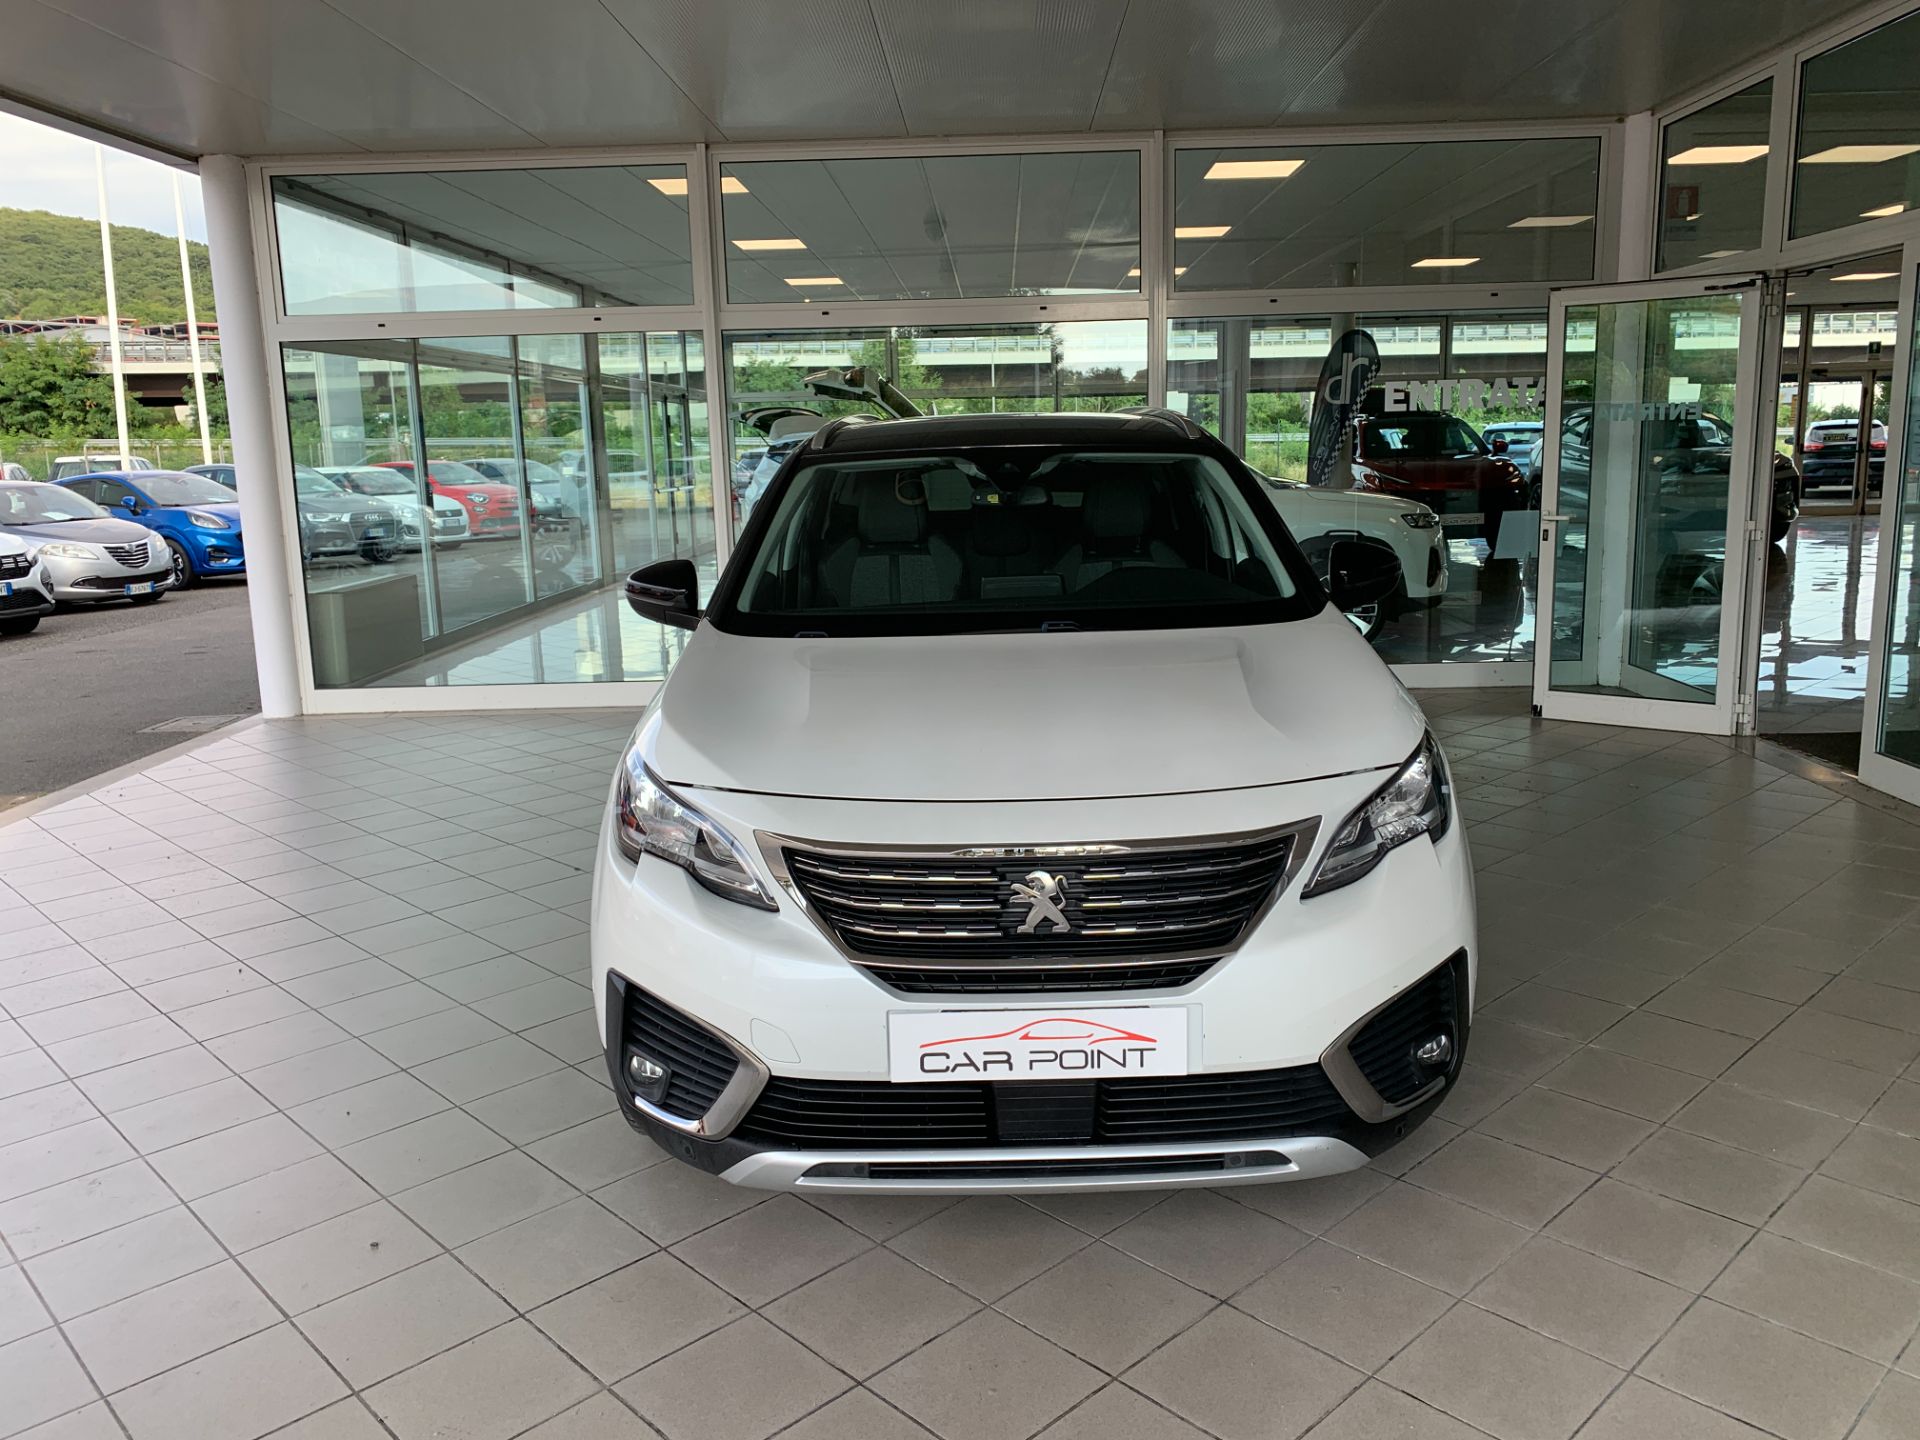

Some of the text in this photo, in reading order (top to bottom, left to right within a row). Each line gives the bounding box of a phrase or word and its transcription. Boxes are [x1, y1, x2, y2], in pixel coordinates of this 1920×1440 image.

[1324, 352, 1370, 406] dr
[919, 1048, 1157, 1073] CAR POINT
